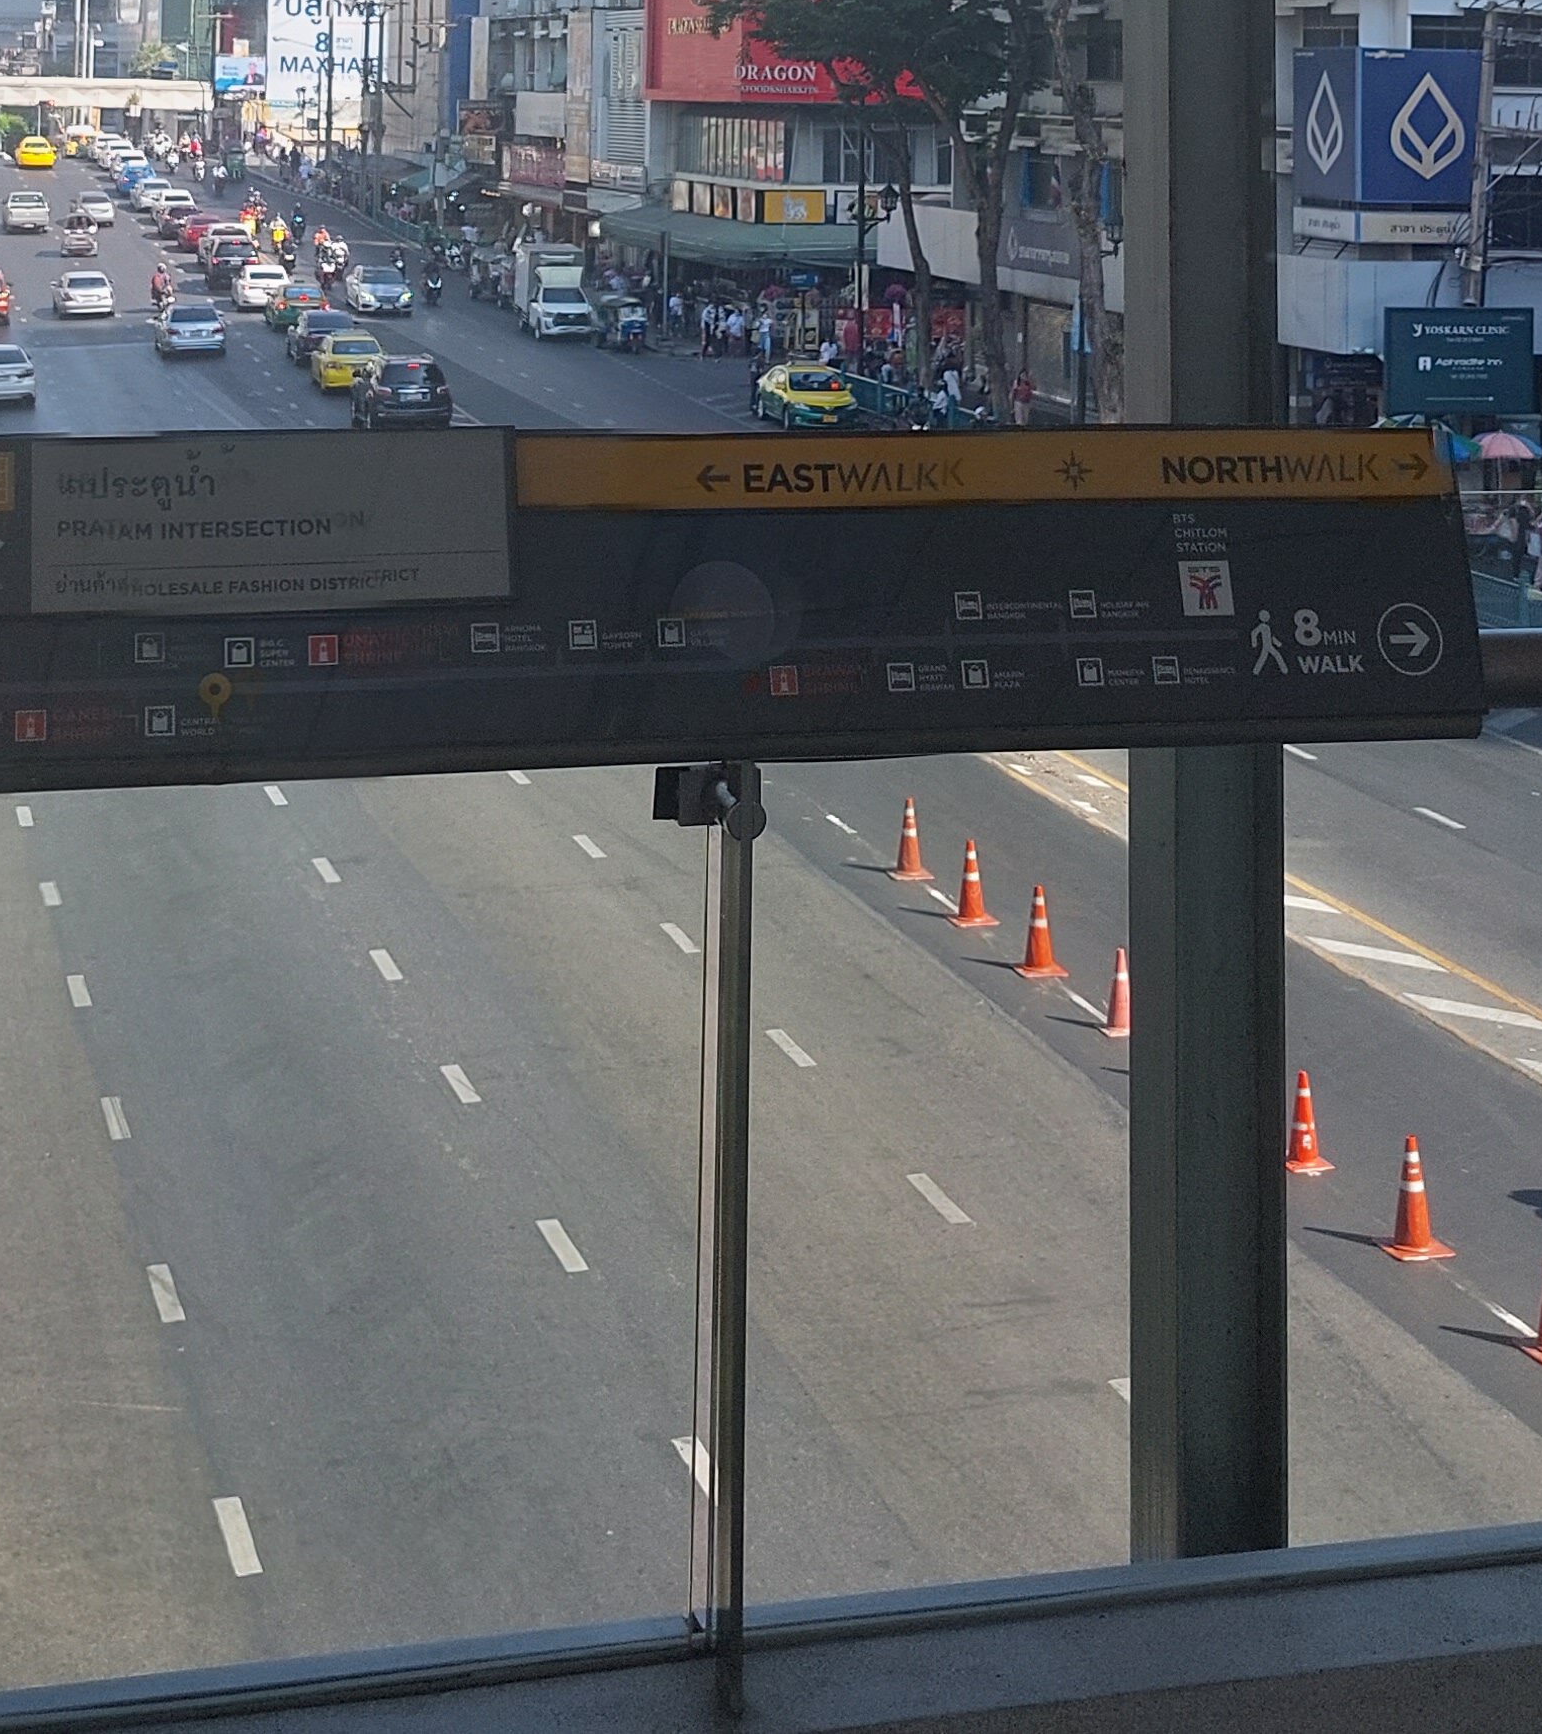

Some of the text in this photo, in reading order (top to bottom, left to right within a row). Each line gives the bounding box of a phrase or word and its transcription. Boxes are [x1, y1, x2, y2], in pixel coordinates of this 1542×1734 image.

[314, 31, 329, 53] 8
[733, 64, 817, 82] DRAGON
[1475, 325, 1509, 335] CLINIC
[1161, 453, 1380, 484] NORTHWALK
[1172, 513, 1196, 524] BTS
[160, 517, 331, 542] INTERSECTION
[228, 576, 306, 594] FASHION
[1293, 608, 1357, 647] 8 MIN
[1297, 654, 1365, 675] WALK
